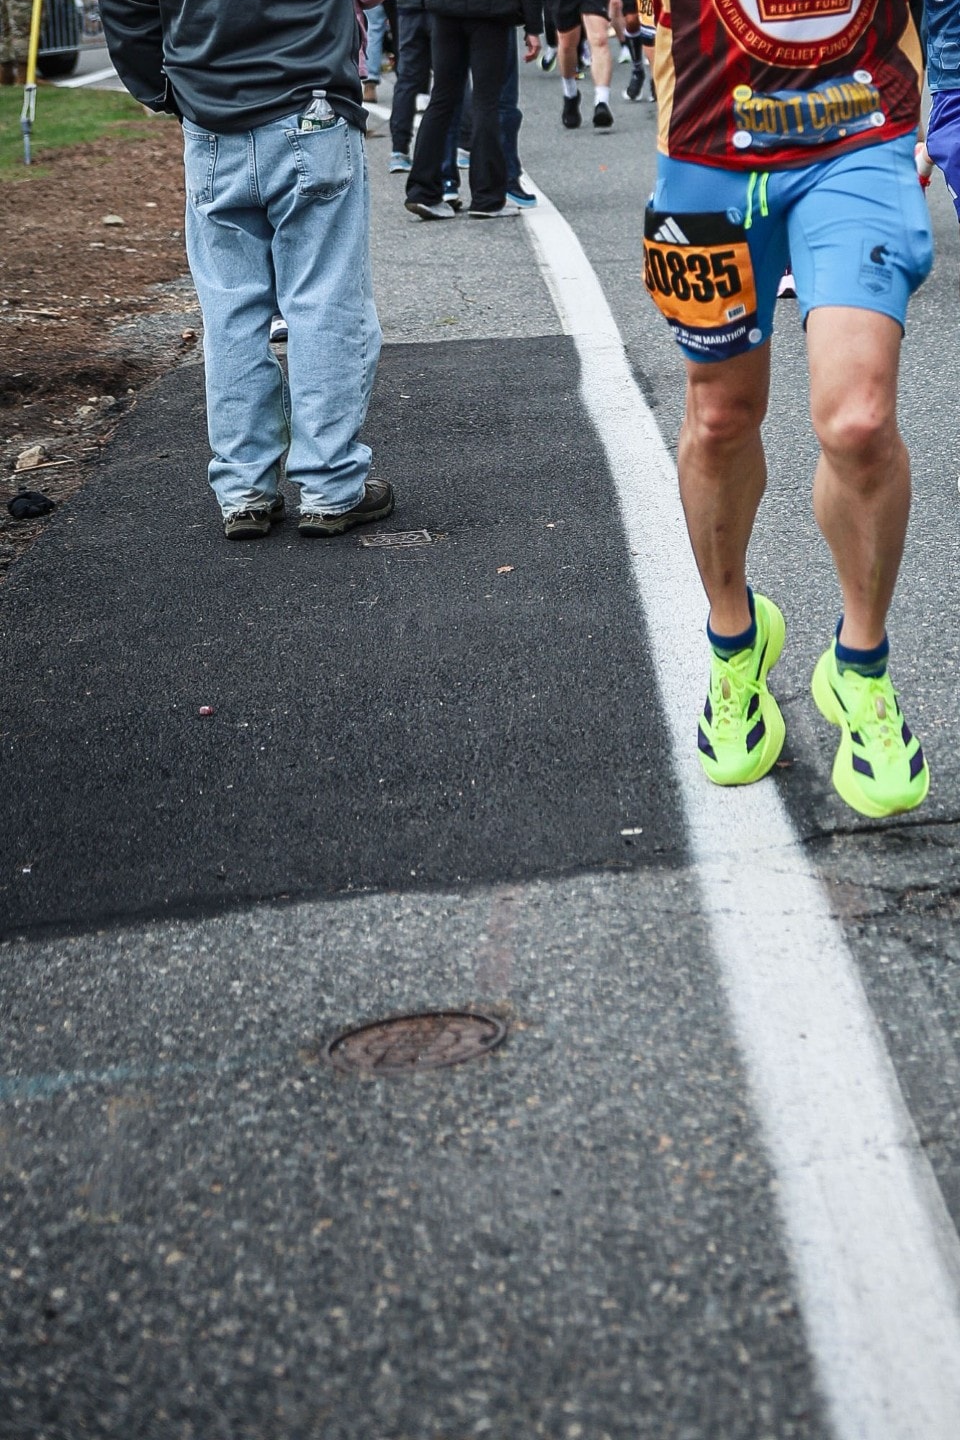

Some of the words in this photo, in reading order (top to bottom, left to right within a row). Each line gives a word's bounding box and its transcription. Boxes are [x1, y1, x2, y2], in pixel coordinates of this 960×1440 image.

[770, 2, 811, 14] RELIEF
[727, 6, 748, 34] FIRE
[745, 31, 773, 56] DEPT.
[775, 46, 817, 61] RELIEF
[818, 36, 849, 59] FUND
[735, 97, 804, 135] SCOTT
[702, 325, 746, 346] MARATHON
